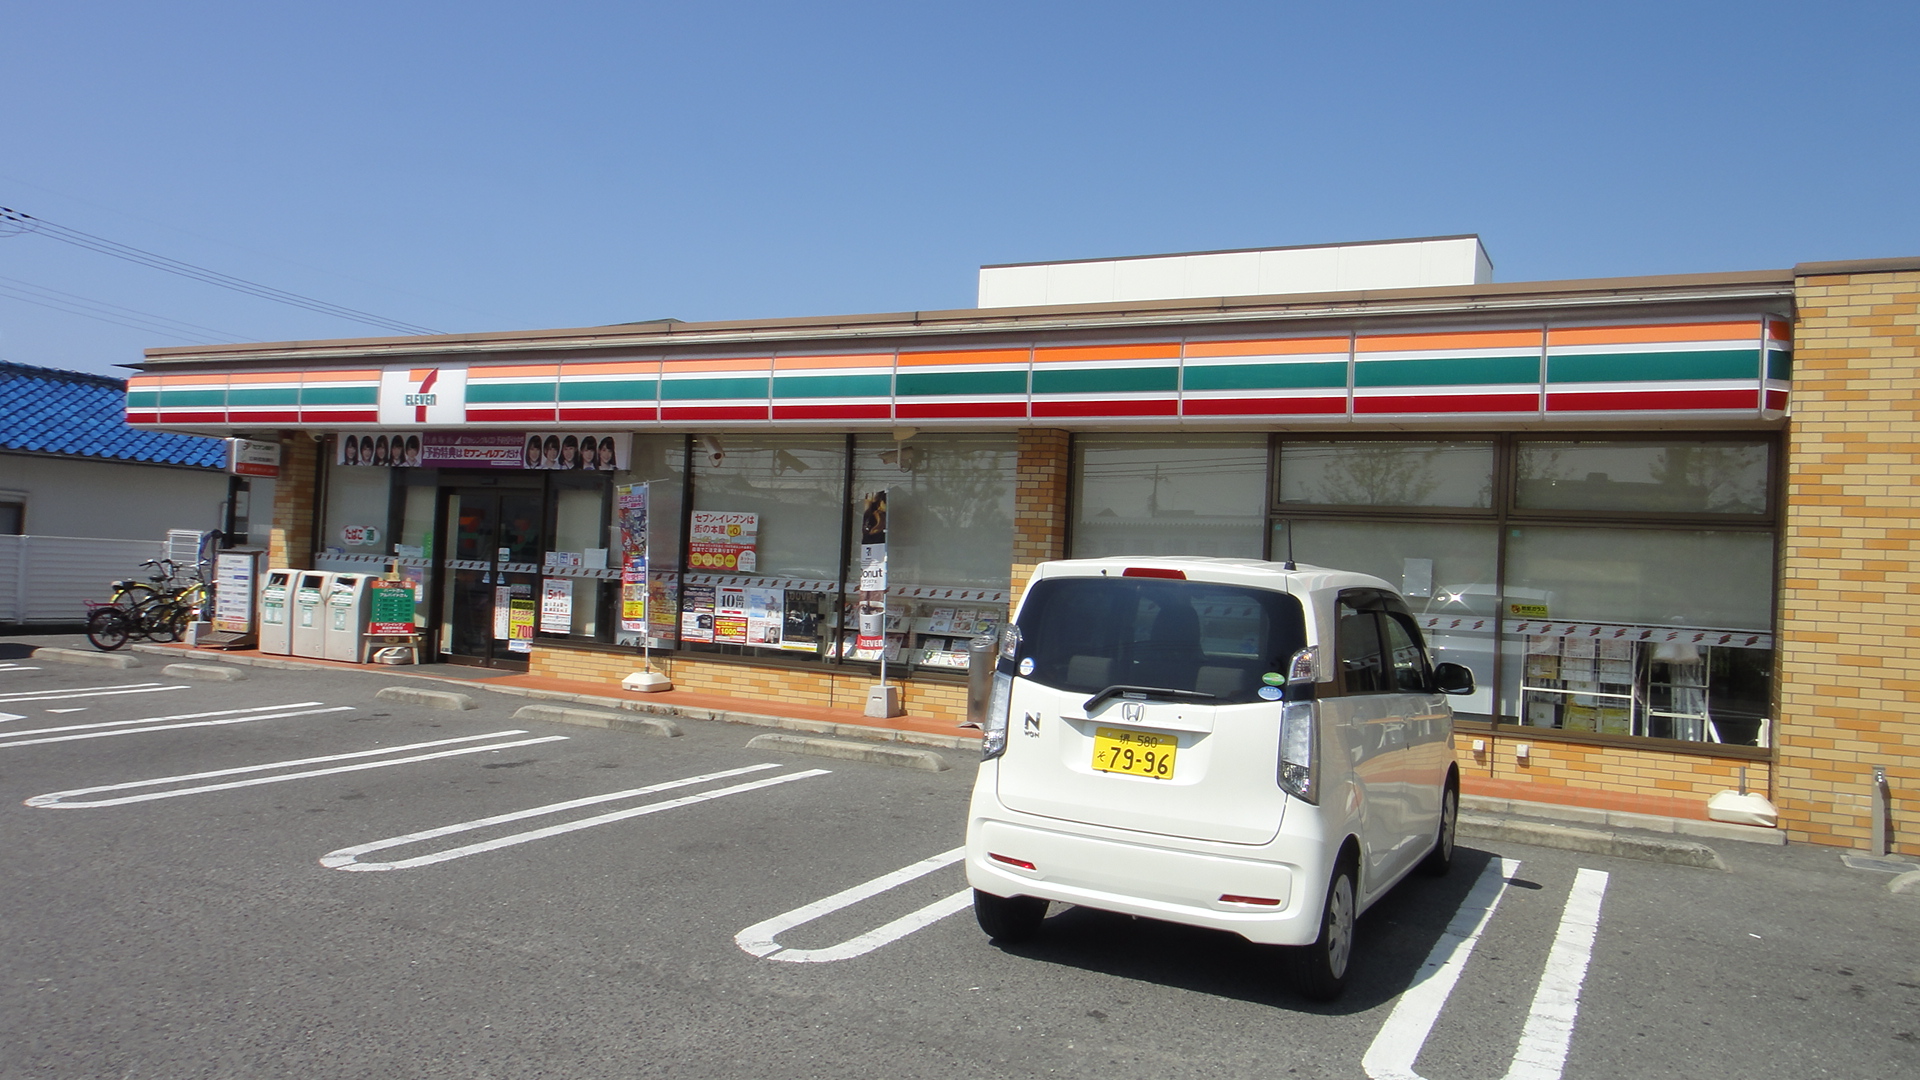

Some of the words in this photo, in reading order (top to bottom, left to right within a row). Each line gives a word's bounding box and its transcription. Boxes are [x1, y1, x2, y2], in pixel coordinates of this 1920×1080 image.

[409, 368, 439, 422] 7
[345, 528, 363, 540] たばこ
[1024, 711, 1041, 732] N
[1119, 733, 1130, 745] 堺
[1137, 735, 1157, 748] 580
[1109, 746, 1170, 775] 79-96
